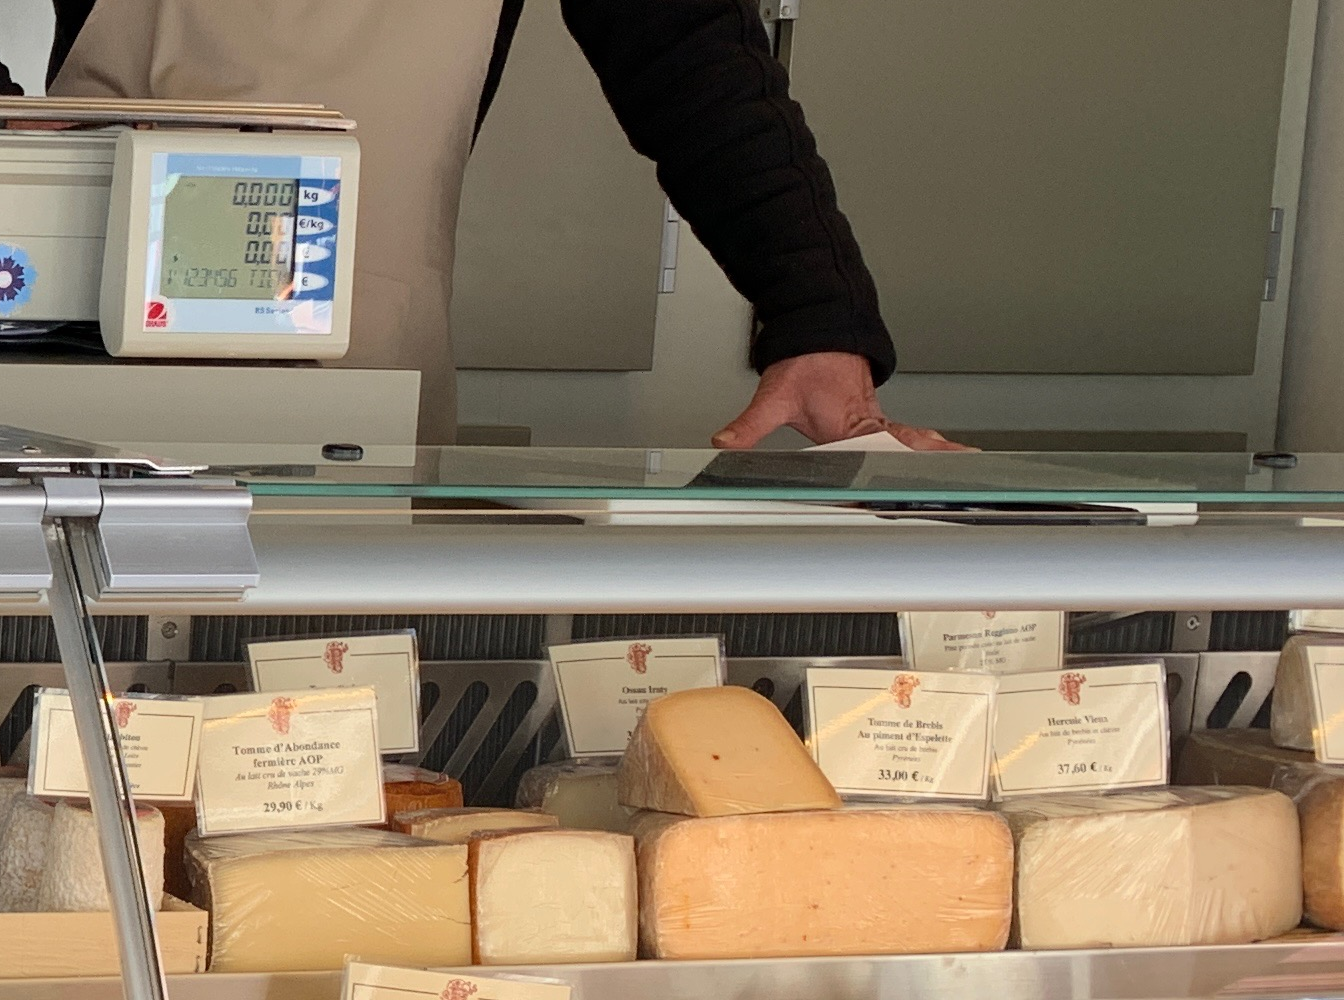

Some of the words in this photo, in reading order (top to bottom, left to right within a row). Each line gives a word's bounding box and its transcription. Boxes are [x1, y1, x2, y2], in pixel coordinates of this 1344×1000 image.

[304, 190, 319, 202] kg
[299, 218, 324, 230] €/kg
[302, 276, 308, 286] €
[943, 632, 982, 641] Parmesan
[1020, 623, 1037, 633] AOP
[868, 718, 900, 727] Tomme
[903, 720, 913, 728] de
[916, 720, 943, 730] Brebis
[1048, 717, 1082, 726] Hercule
[857, 730, 870, 739] Au
[873, 732, 903, 741] piment
[232, 745, 271, 755] Tomme
[273, 741, 341, 752] d'Abondance
[253, 757, 296, 768] fermière
[299, 755, 323, 765] AOP
[1058, 763, 1087, 775] 37,60
[1090, 761, 1097, 772] €
[235, 773, 246, 781] Au
[878, 769, 908, 781] 33,00
[912, 771, 919, 781] €
[293, 780, 315, 790] Alpes
[264, 801, 292, 813] 29,90
[295, 800, 302, 810] €
